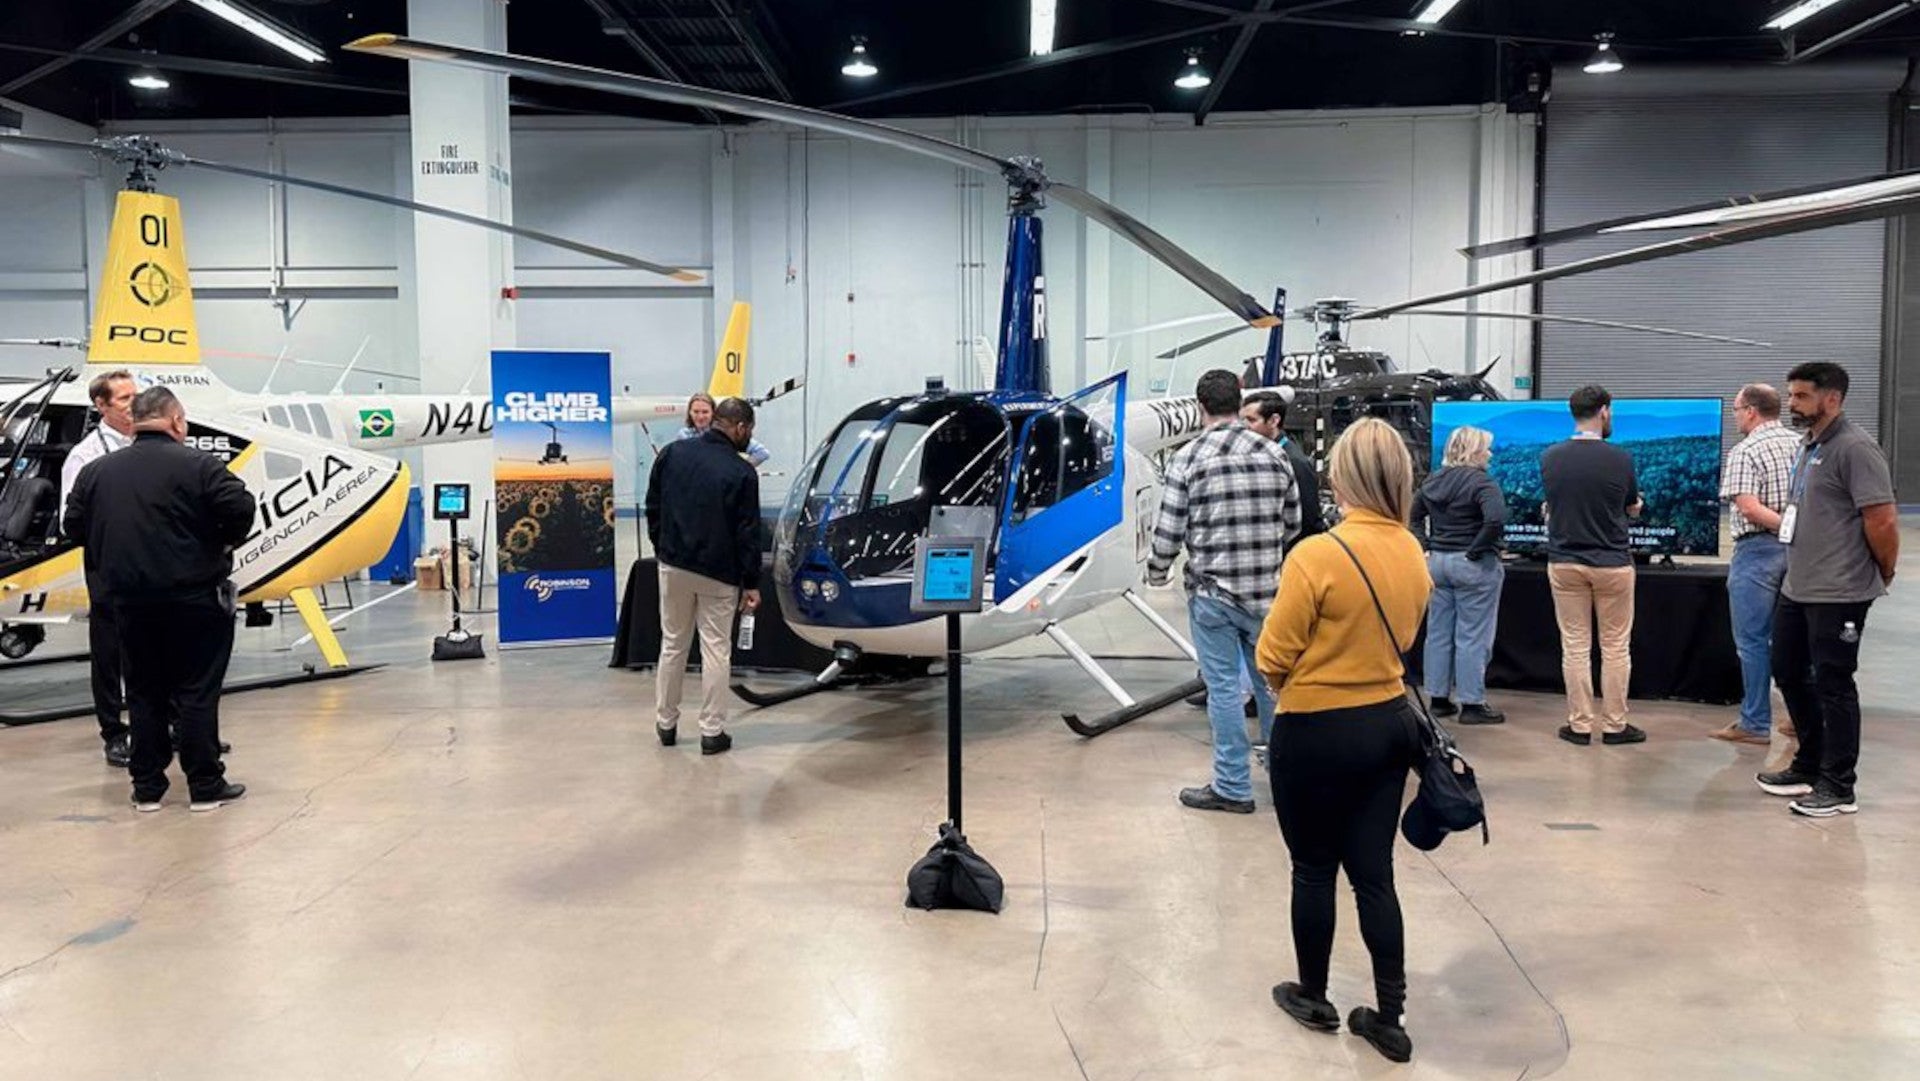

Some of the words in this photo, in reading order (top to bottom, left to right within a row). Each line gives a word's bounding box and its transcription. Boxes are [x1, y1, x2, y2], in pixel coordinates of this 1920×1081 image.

[440, 145, 459, 158] FIRE
[421, 161, 479, 174] EXTINGUISHER
[141, 214, 168, 249] 01
[109, 325, 188, 345] POC
[726, 352, 740, 374] 01
[156, 374, 210, 386] SAFRAN
[504, 391, 599, 407] CLIMB
[497, 407, 607, 422] HIGHER
[231, 509, 319, 574] IGÊNCIA
[324, 465, 379, 511] AÉREA
[1645, 526, 1676, 537] people
[540, 578, 590, 588] ROBINSON
[20, 592, 47, 613] H
